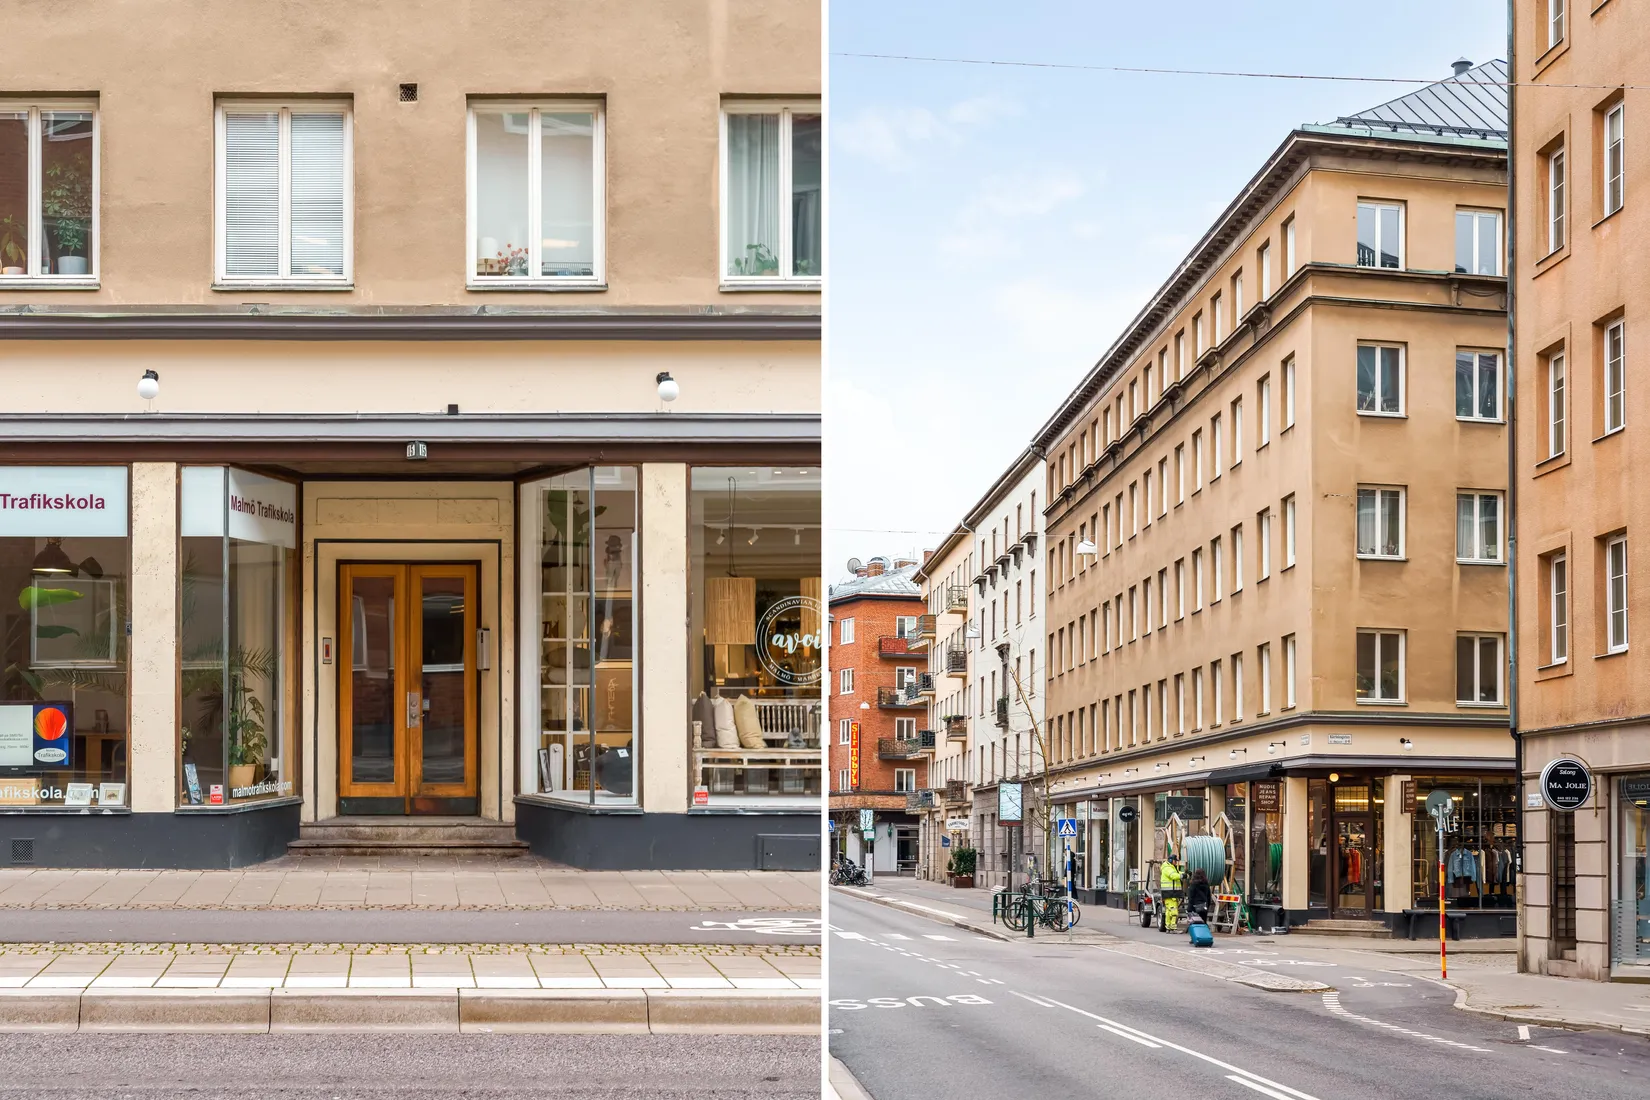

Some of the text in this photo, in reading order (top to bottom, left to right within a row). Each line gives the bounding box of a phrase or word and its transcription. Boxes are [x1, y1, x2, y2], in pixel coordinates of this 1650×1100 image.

[0, 493, 105, 509] Trafikskola
[231, 495, 294, 524] Malmö Trafikskola
[765, 599, 813, 621] SCANDINAVIAN
[769, 663, 791, 680] MALMÖ
[0, 786, 99, 799] fikskola.m
[828, 994, 994, 1010] BUSS
